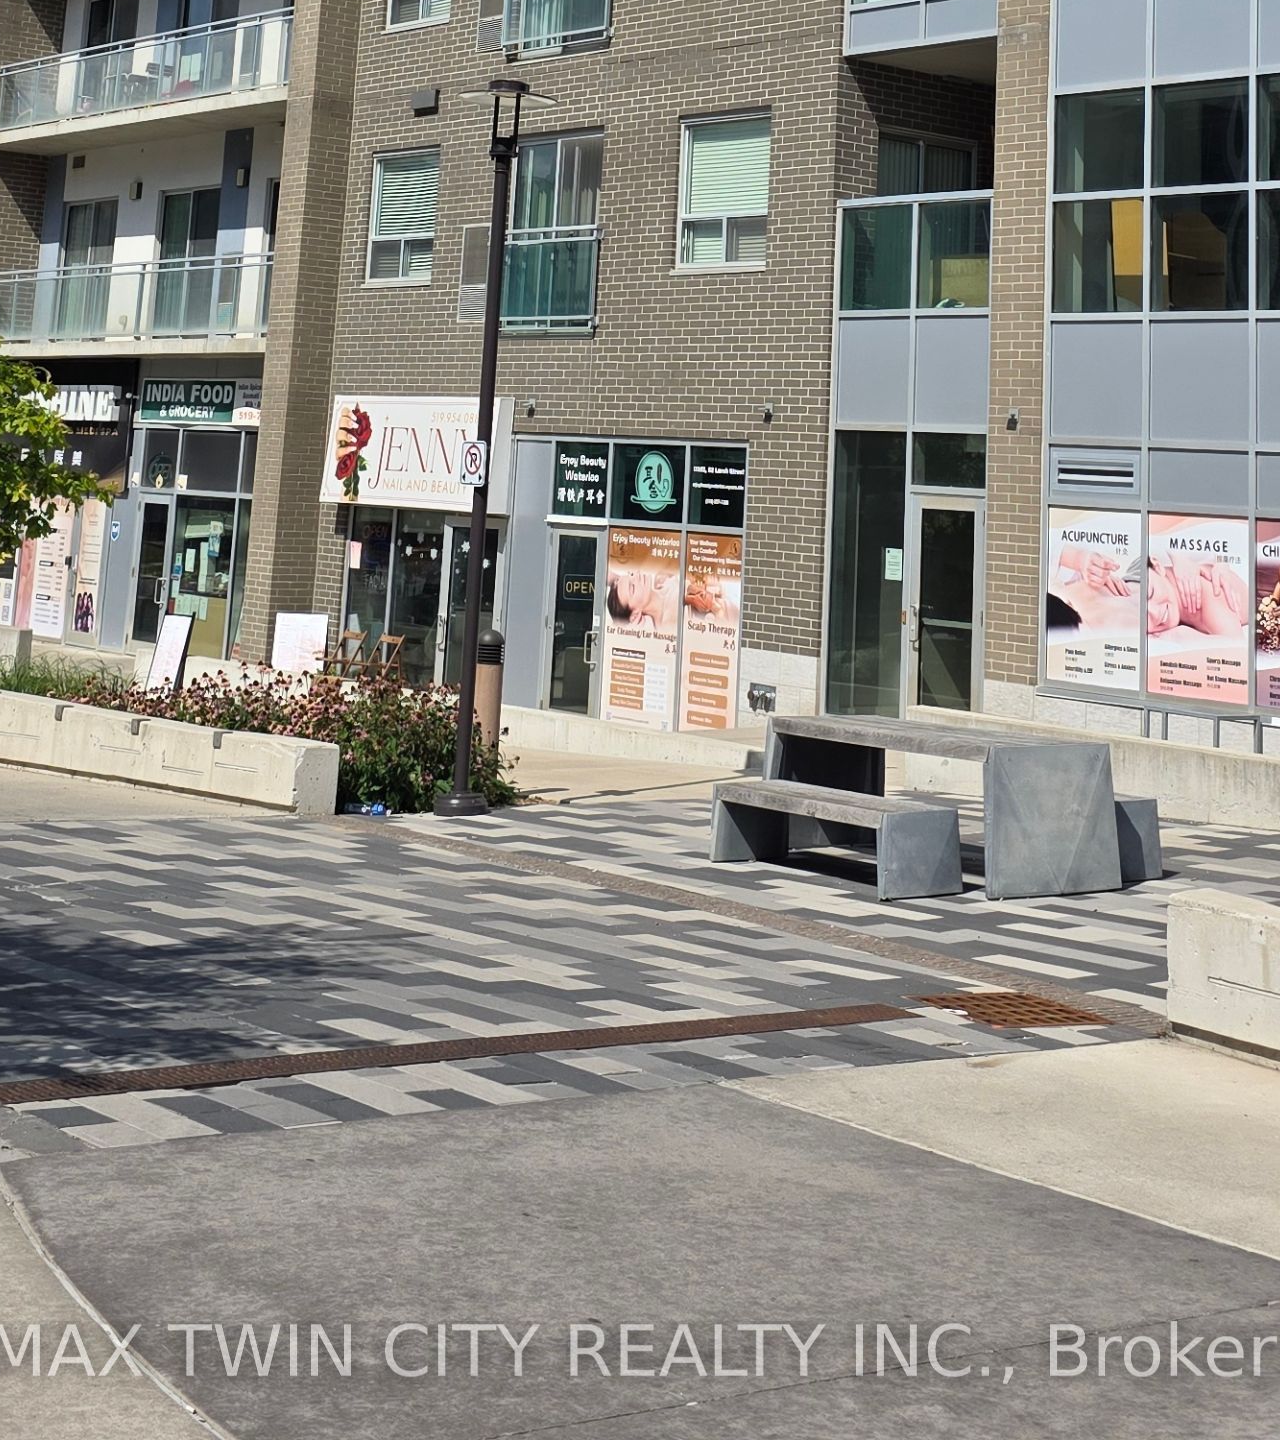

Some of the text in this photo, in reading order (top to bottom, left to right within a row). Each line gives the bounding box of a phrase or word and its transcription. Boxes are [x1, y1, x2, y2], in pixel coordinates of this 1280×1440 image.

[146, 384, 185, 402] INDIA
[190, 385, 234, 404] FOOD
[160, 405, 216, 418] & GROCERY
[580, 455, 607, 469] Beauty
[565, 470, 600, 482] Waterloo
[383, 480, 467, 495] NAIL AND BEAUTY
[629, 534, 651, 547] Beauty
[652, 536, 680, 547] Waterloo
[1061, 530, 1129, 546] ACUPUNCTURE
[1169, 538, 1228, 553] MASSAGE
[566, 581, 595, 594] OPEN
[607, 626, 616, 634] Ear
[688, 620, 737, 637] Scalp Therapy
